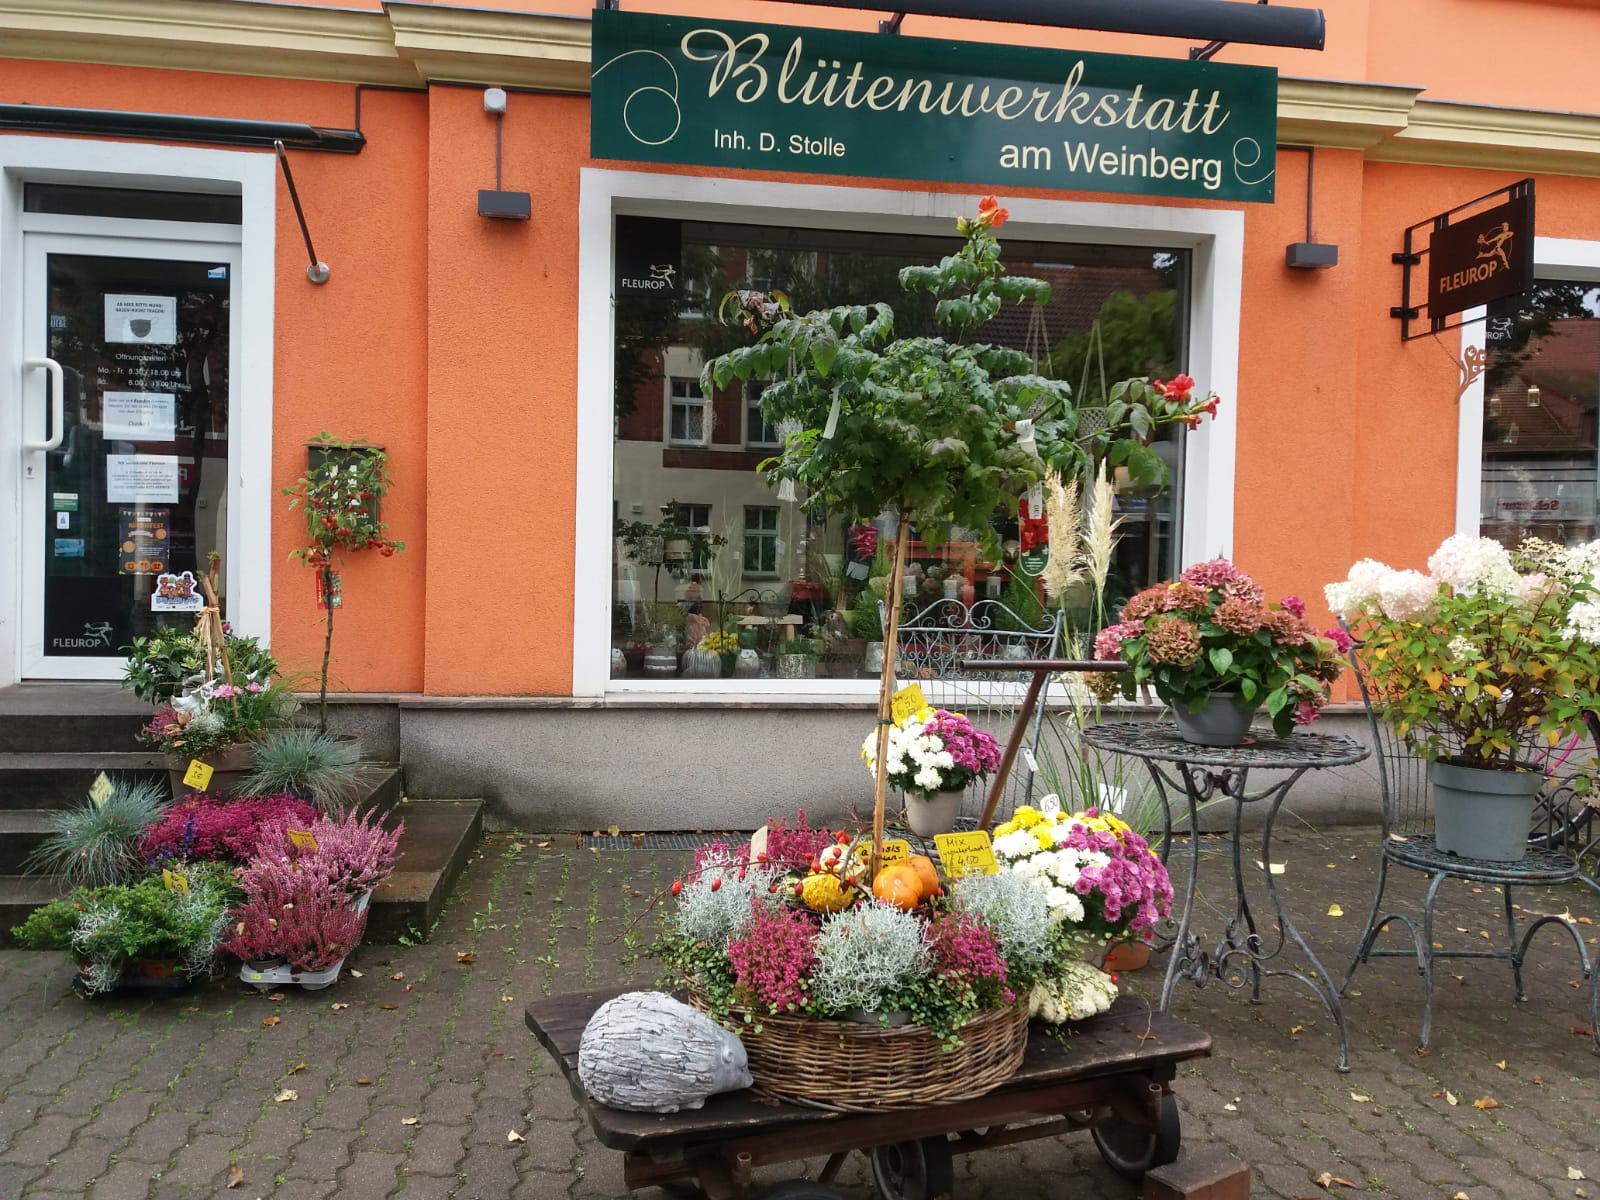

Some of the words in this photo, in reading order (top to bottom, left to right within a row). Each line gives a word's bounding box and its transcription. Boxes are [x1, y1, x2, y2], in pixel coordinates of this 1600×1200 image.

[681, 28, 1230, 135] Blütenwerkstatt
[714, 129, 752, 150] Inh.
[759, 132, 782, 152] D.
[788, 134, 846, 157] Stolle
[999, 144, 1051, 170] am
[1064, 141, 1222, 190] Weinberg
[622, 278, 665, 289] FLEUROP
[1440, 260, 1497, 293] FLEUROP
[53, 638, 101, 648] FLEUROP
